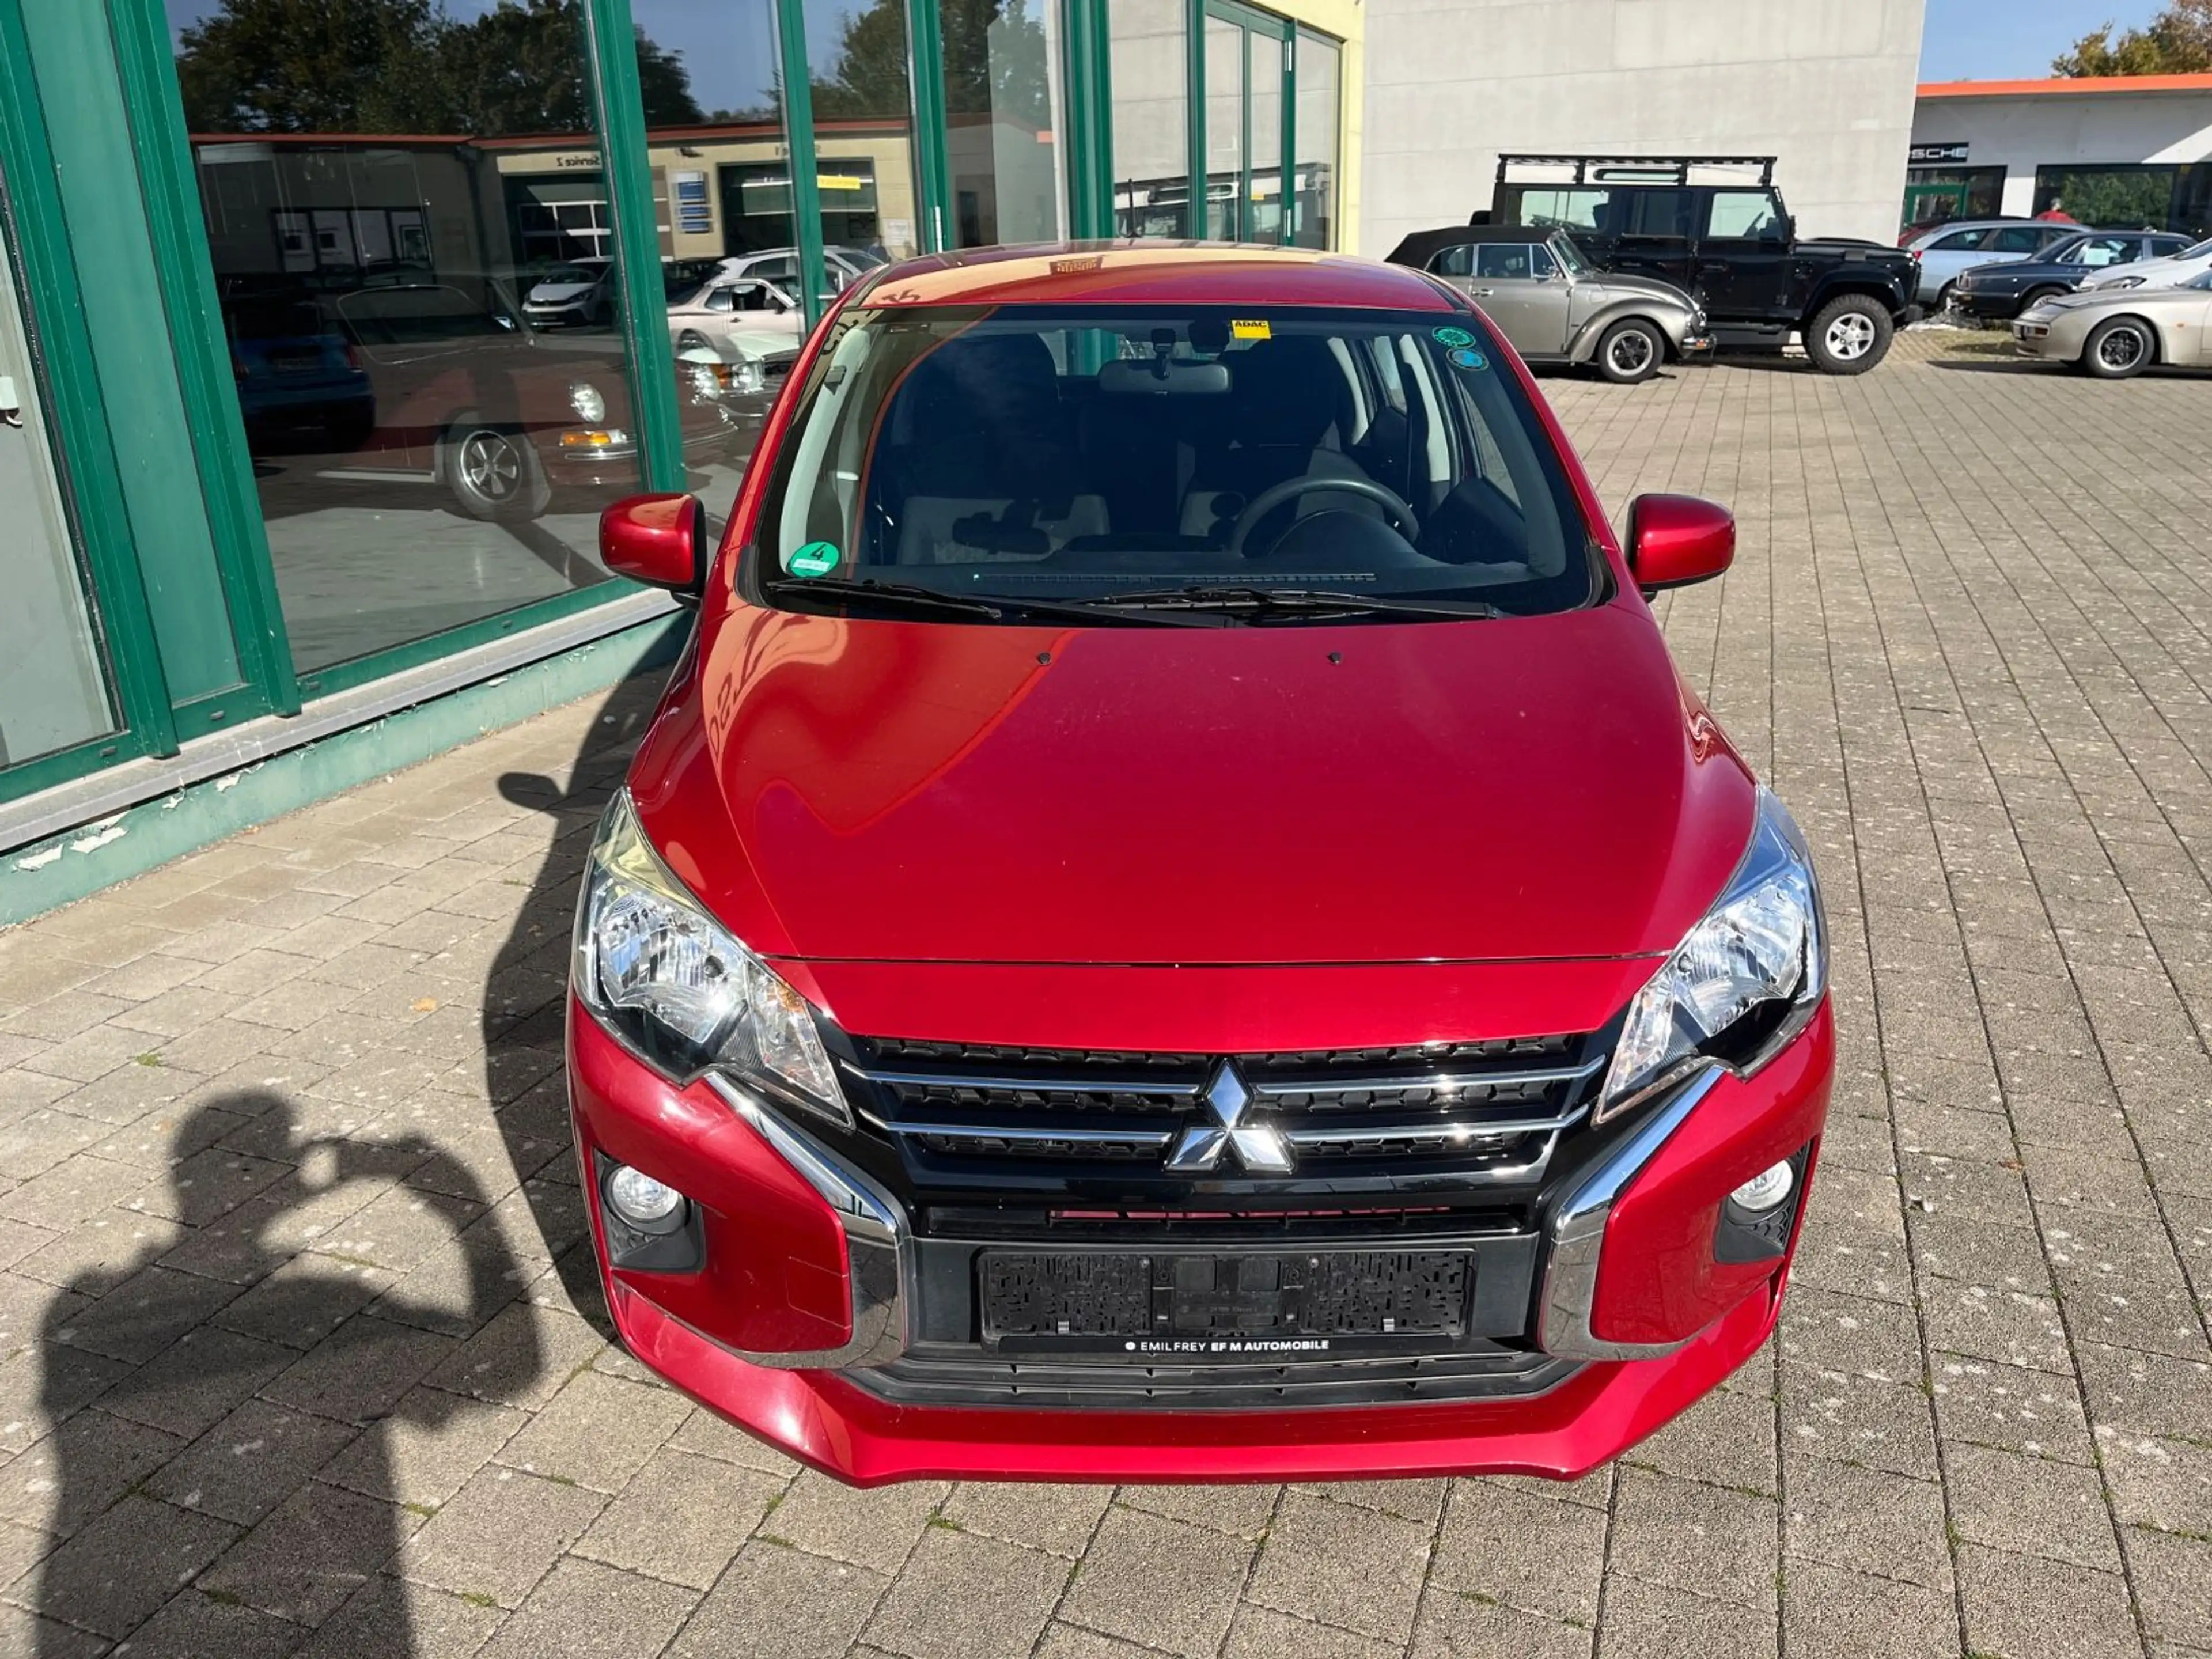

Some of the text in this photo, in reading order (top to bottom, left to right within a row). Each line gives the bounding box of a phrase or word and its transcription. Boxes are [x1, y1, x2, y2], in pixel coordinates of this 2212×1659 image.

[1910, 147, 1969, 159] SCHE
[810, 543, 827, 560] 4
[1229, 1342, 1241, 1351] M
[1244, 1339, 1330, 1351] AUTOMOBILE
